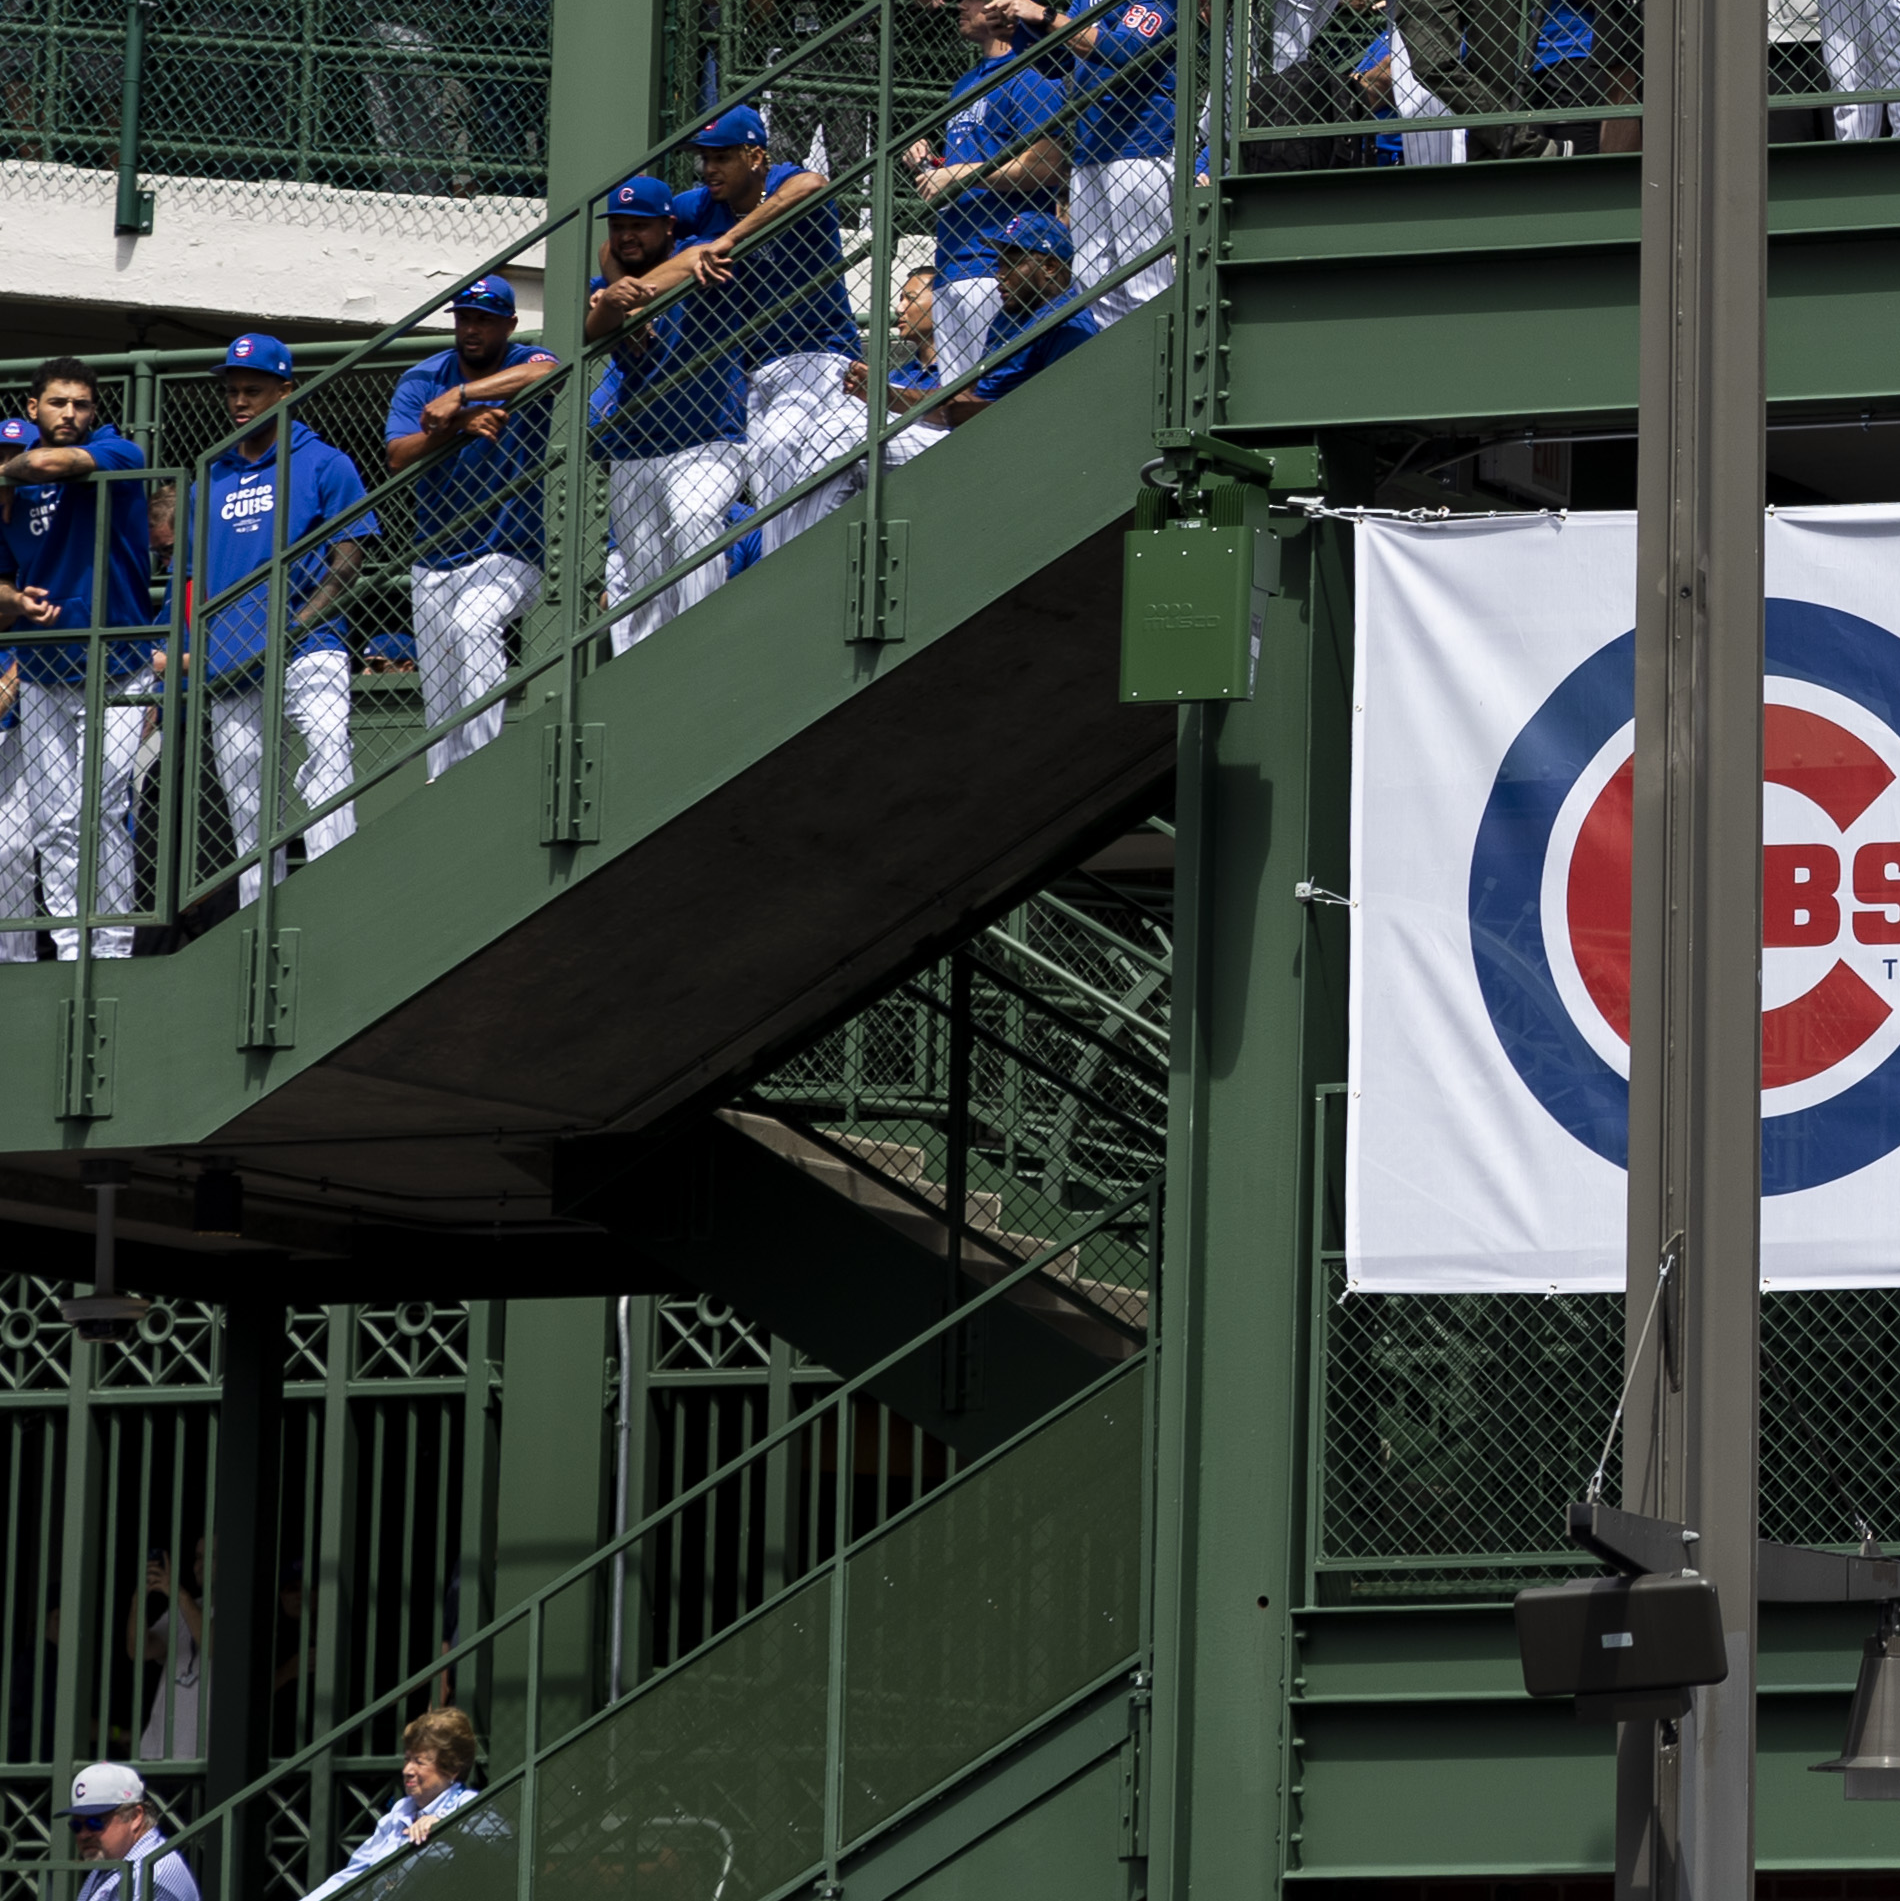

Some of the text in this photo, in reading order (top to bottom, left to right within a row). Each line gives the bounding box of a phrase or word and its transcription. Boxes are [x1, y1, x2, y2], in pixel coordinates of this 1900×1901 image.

[1122, 4, 1164, 38] 80
[619, 187, 635, 204] C
[221, 494, 275, 520] CUBS
[75, 1782, 87, 1799] C
